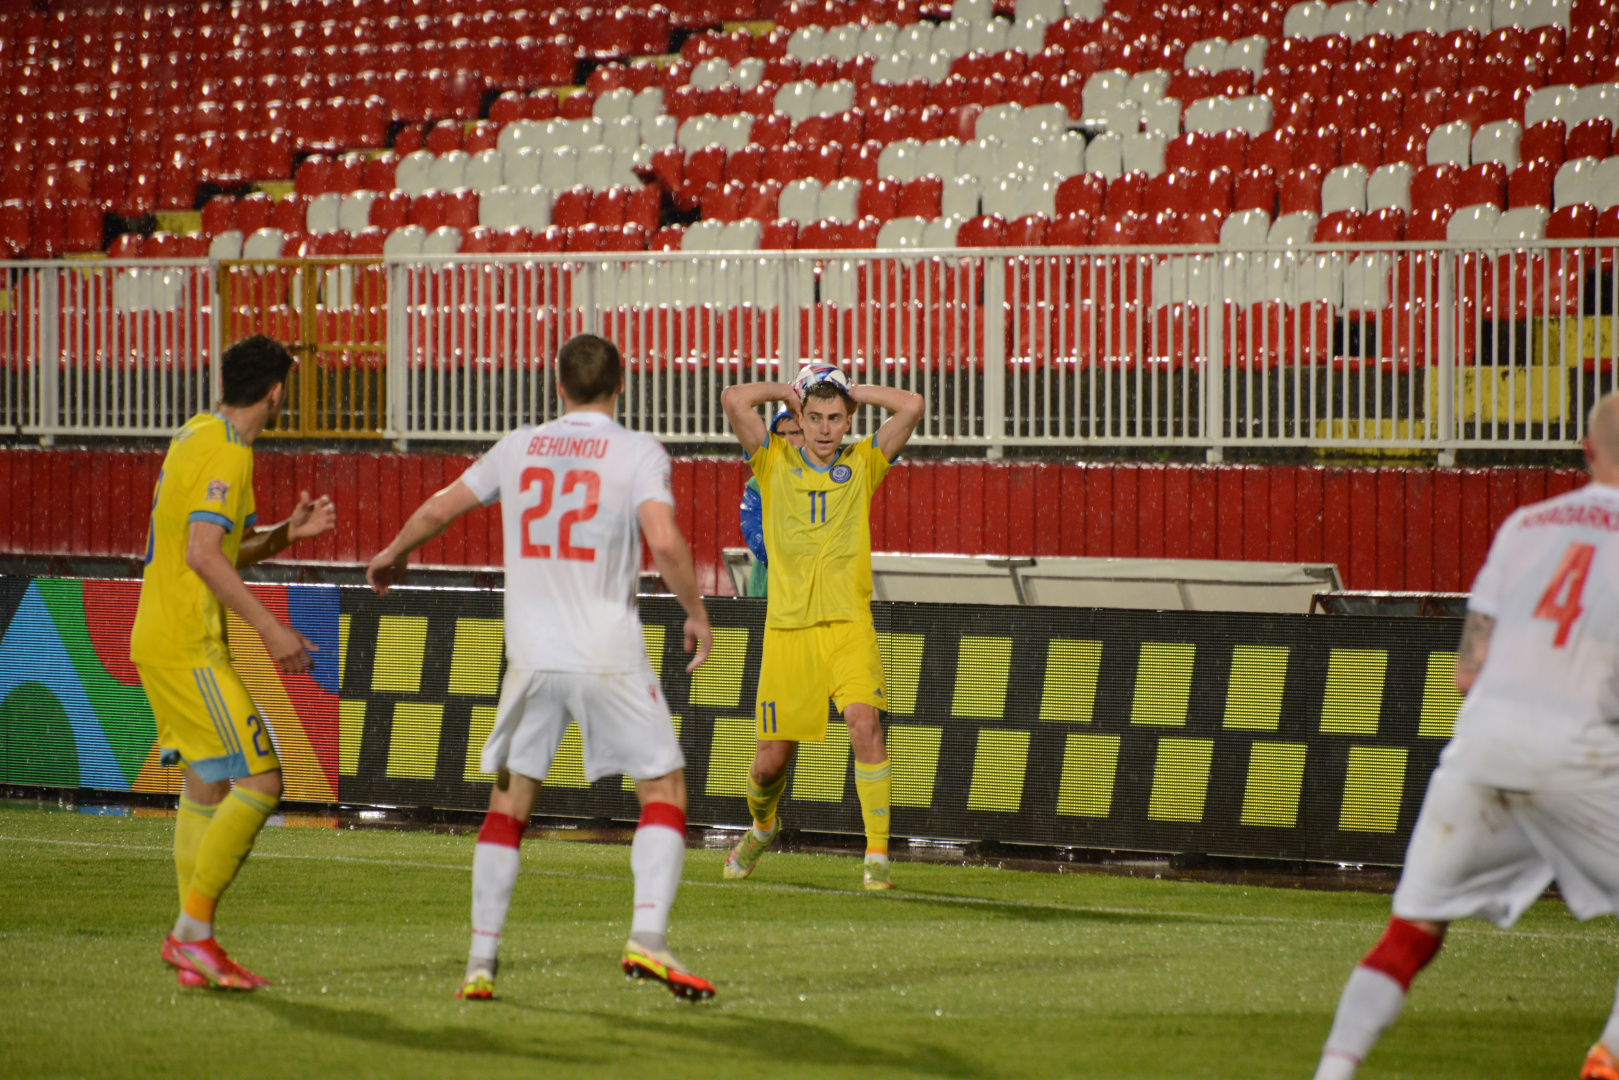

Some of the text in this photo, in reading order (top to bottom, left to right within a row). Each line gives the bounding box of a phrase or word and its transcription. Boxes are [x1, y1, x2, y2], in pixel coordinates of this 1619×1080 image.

[526, 436, 608, 459] BEHUNOU
[519, 466, 601, 562] 22
[807, 491, 826, 523] 11
[1532, 541, 1597, 648] 4
[761, 701, 777, 733] 11
[247, 715, 269, 757] 2
